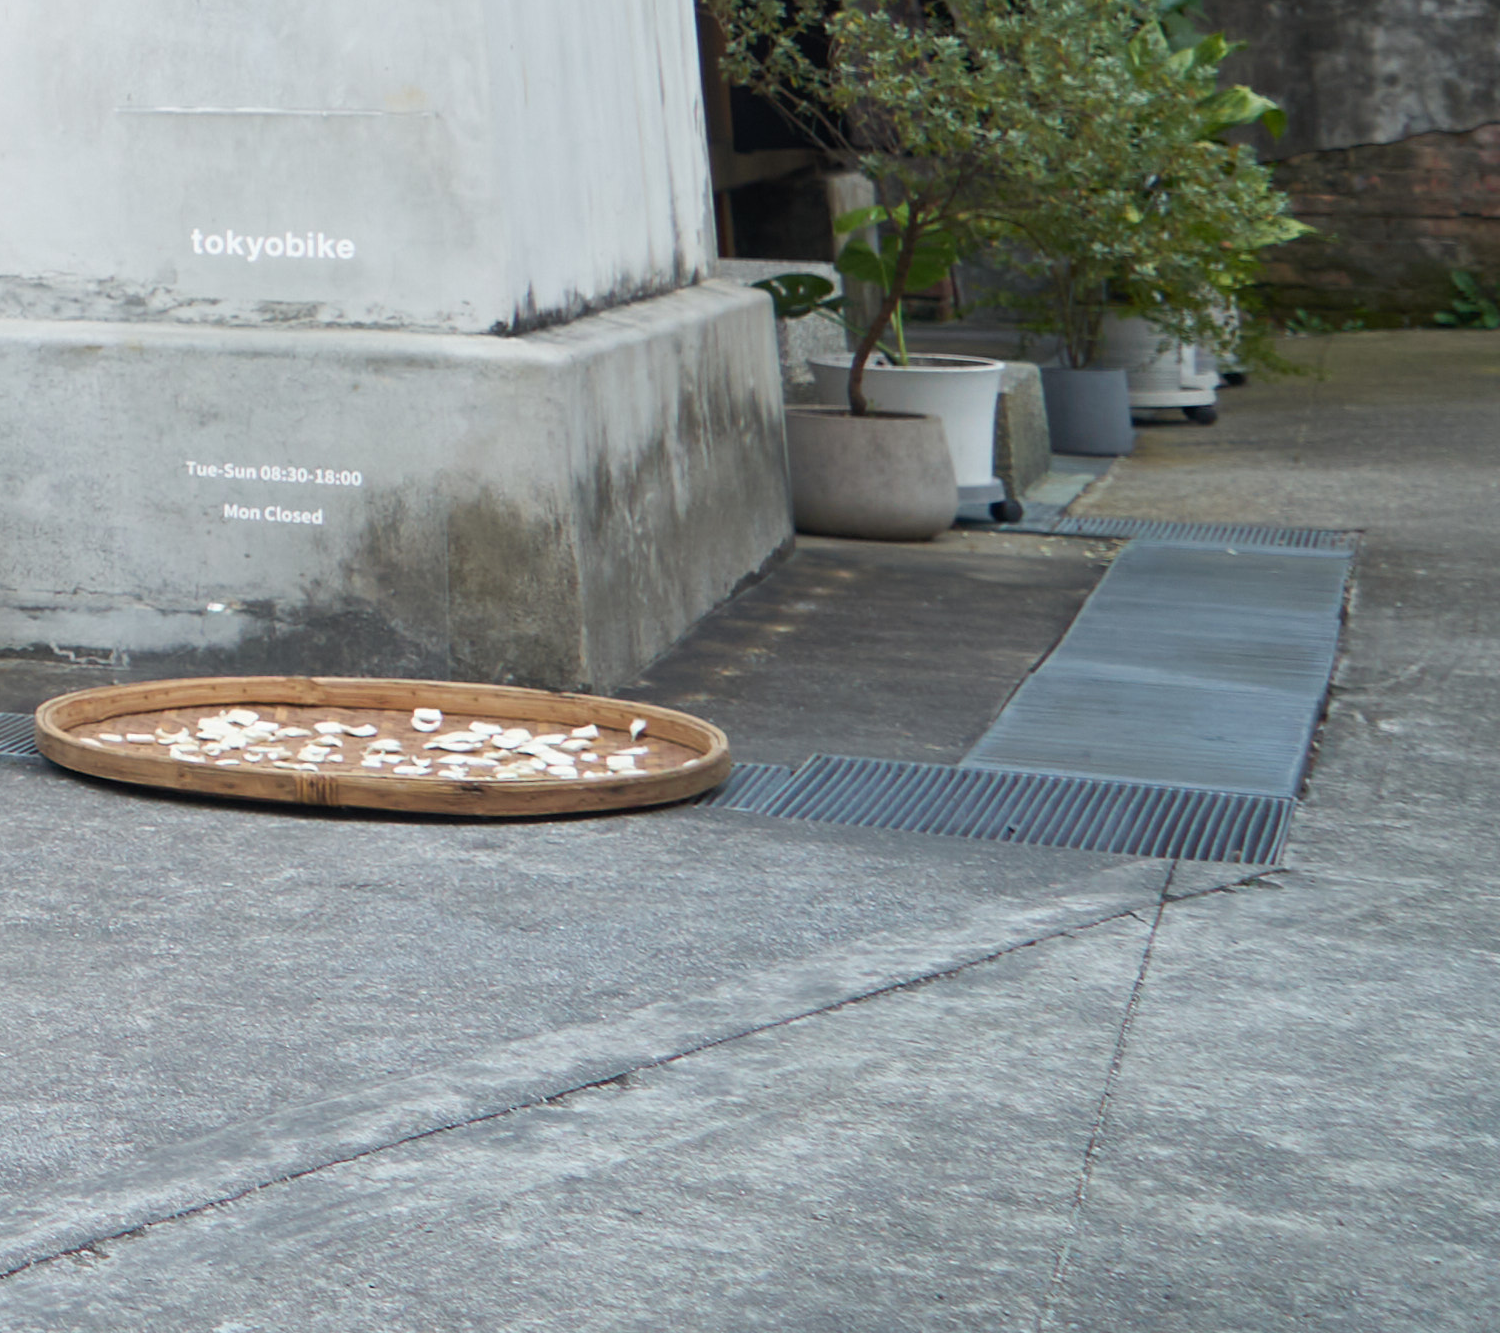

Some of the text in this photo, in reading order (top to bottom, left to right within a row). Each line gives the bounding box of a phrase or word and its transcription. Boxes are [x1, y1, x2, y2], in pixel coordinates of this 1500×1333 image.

[191, 228, 356, 263] tokyobike
[185, 460, 363, 486] Tue-Sun 08:30-18:00
[223, 503, 324, 525] Mon Closed
